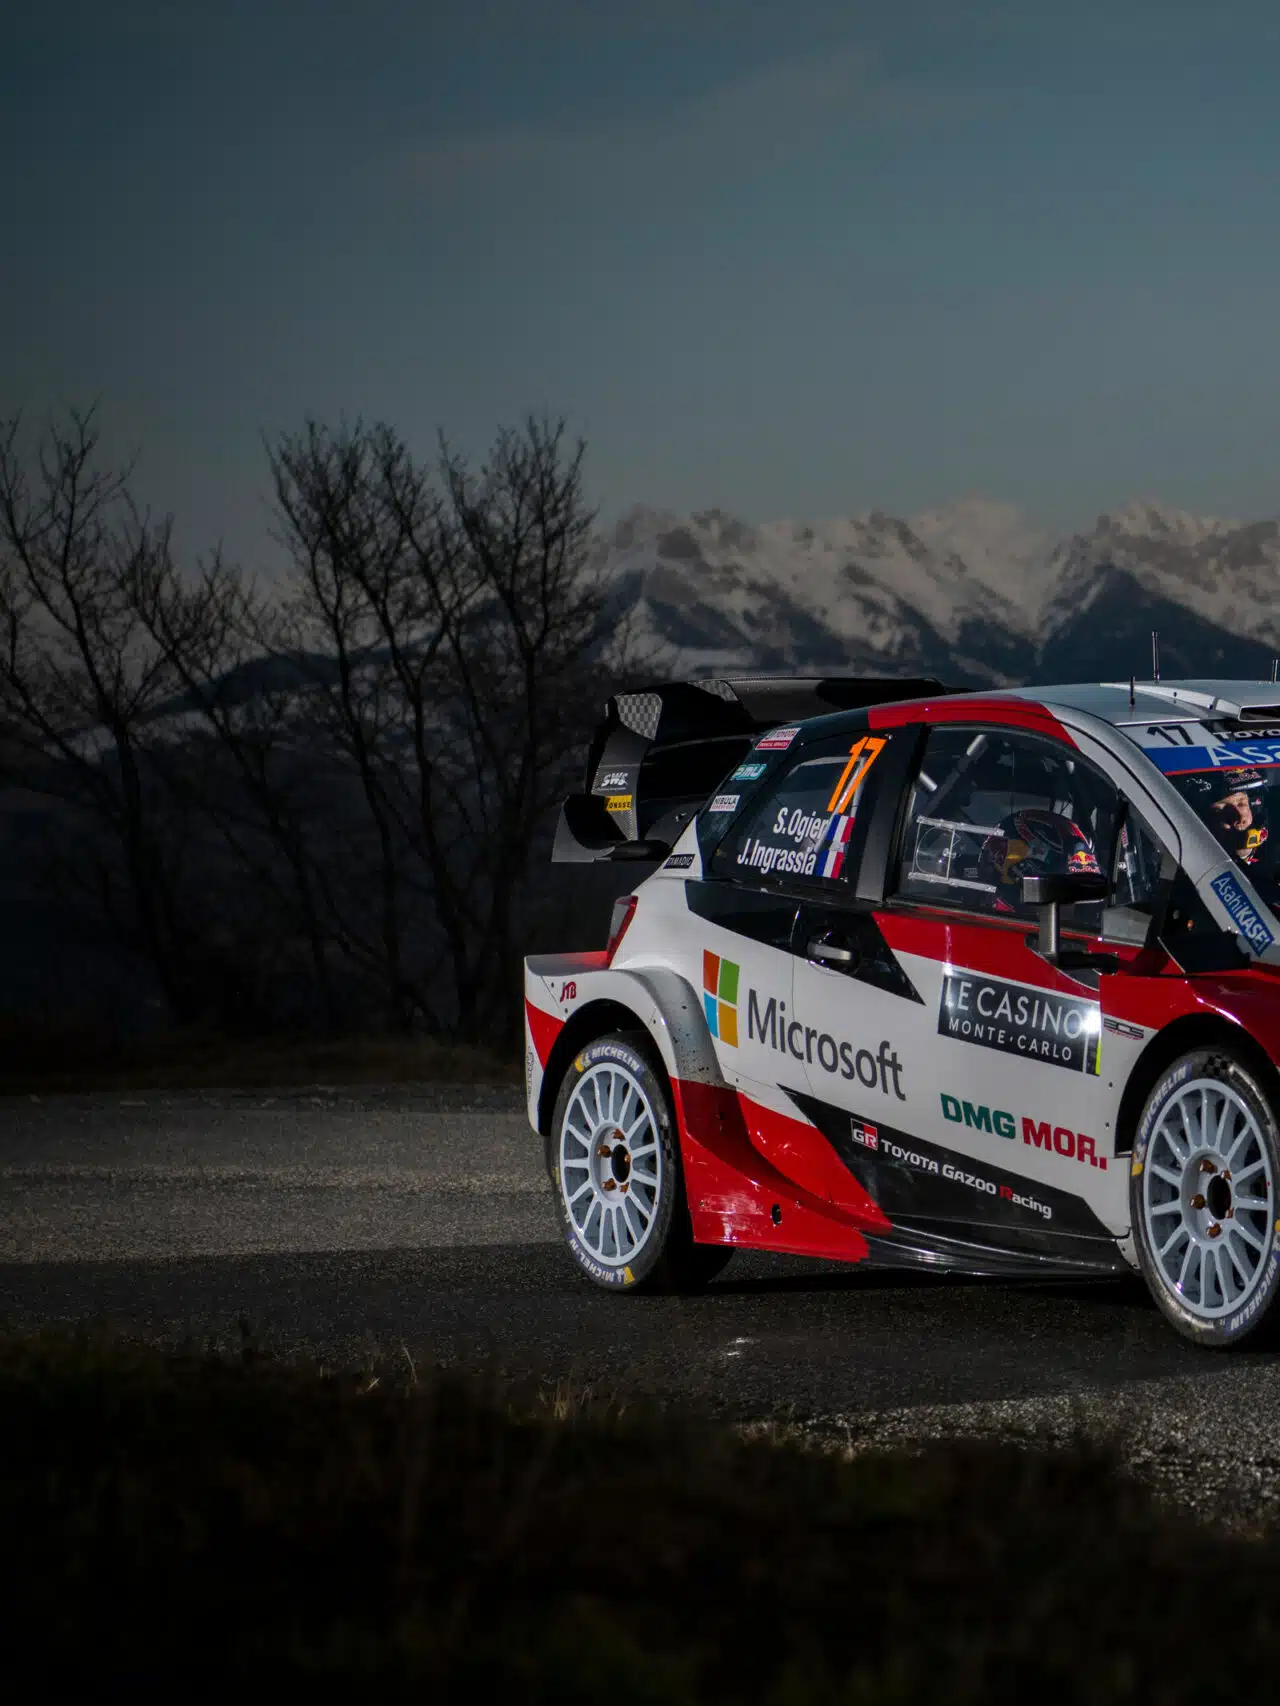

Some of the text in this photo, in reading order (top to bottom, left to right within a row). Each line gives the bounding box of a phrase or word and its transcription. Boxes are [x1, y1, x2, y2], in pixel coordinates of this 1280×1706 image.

[1147, 725, 1194, 746] 17
[827, 736, 888, 814] 17
[608, 801, 632, 809] ONSSE
[773, 807, 830, 843] S.Ogier
[737, 838, 817, 876] J.Ingrassia
[1214, 877, 1270, 951] AsahiKASEI
[945, 978, 1083, 1040] LE CASINO
[592, 1045, 641, 1072] MICHELIN
[748, 988, 907, 1101] Microsoft
[940, 1093, 1017, 1140] DMG
[1140, 1065, 1187, 1139] MICHELIN
[853, 1128, 878, 1149] GR
[881, 1138, 1053, 1219] TOYOTA GAZOO Racing
